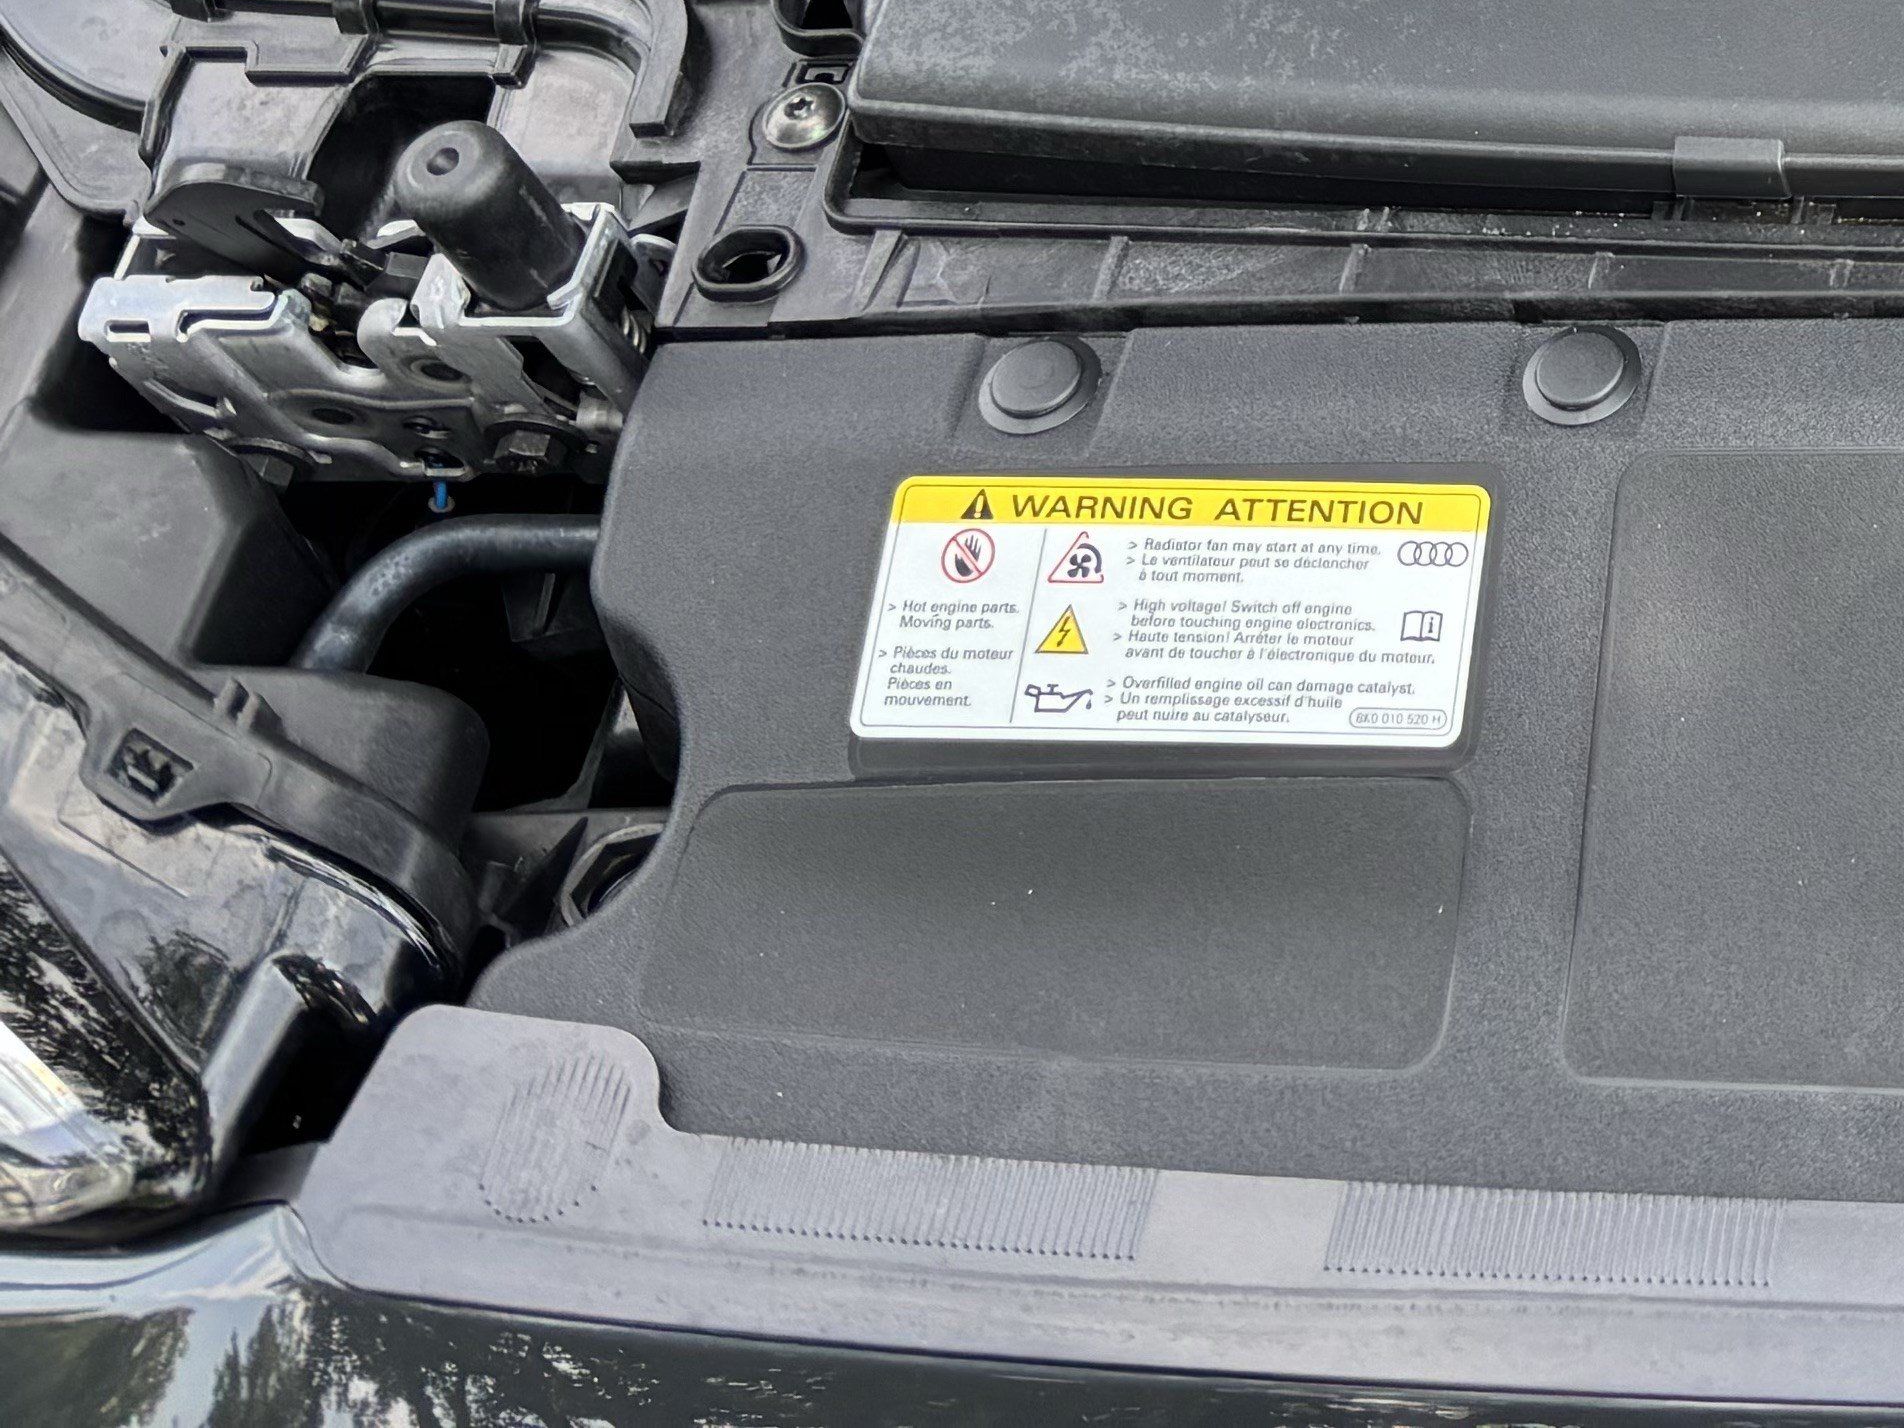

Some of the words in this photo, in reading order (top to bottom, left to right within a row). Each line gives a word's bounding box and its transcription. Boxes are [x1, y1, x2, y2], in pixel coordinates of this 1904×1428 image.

[1012, 494, 1192, 520] WARNING
[1213, 497, 1423, 524] ATTENTION
[1143, 537, 1202, 551] Radiator
[1206, 538, 1228, 551] fan
[1232, 542, 1262, 553] may
[1265, 541, 1297, 552] start
[1300, 542, 1313, 553] at
[1317, 543, 1342, 555] any
[1347, 542, 1380, 555] time.
[1141, 553, 1157, 566] Le
[1162, 554, 1235, 567] ventilateur
[1238, 557, 1270, 569] peut
[1273, 558, 1289, 568] se
[1293, 556, 1369, 570] déclencher
[1150, 569, 1178, 581] tout
[1182, 571, 1243, 583] moment.
[902, 599, 927, 612] Hot
[930, 601, 977, 615] engine
[980, 602, 1019, 615] parts.
[1133, 598, 1165, 614] High
[1170, 598, 1227, 615] voltage!
[1230, 599, 1277, 613] Switch
[1281, 600, 1301, 614] off
[1303, 602, 1352, 617] engine
[898, 614, 951, 630] Moving
[954, 617, 993, 630] parts.
[1130, 613, 1175, 627] before
[1179, 614, 1241, 631] touching
[1244, 618, 1292, 631] engine
[1296, 616, 1375, 631] electronics.
[1127, 629, 1169, 642] Haute
[1173, 631, 1230, 643] tension!
[1233, 630, 1282, 644] Arrêter
[1286, 632, 1298, 645] le
[1303, 635, 1353, 646] moteur
[893, 645, 936, 659] Pièces
[940, 646, 959, 659] du
[962, 648, 1013, 660] moteur
[1124, 647, 1164, 658] avant
[1167, 646, 1185, 659] de
[1189, 646, 1242, 659] toucher
[1358, 649, 1376, 662] du
[1380, 651, 1434, 664] moteur.
[889, 661, 951, 675] chaudes.
[886, 676, 930, 690] Pièces
[934, 680, 952, 690] en
[1122, 675, 1191, 689] Overfilled
[1194, 677, 1242, 692] engine
[1246, 677, 1264, 691] oil
[1267, 681, 1292, 691] can
[1295, 678, 1353, 695] damage
[1357, 680, 1414, 696] catalyst.
[883, 695, 971, 706] mouvement.
[1119, 691, 1140, 704] Un
[1144, 692, 1230, 708] remplissage
[1233, 694, 1291, 707] excessif
[1115, 709, 1148, 722] peut
[1152, 708, 1188, 721] nuire
[1192, 711, 1209, 721] au
[1213, 710, 1289, 724] catalyseur.
[1406, 713, 1428, 725] 520
